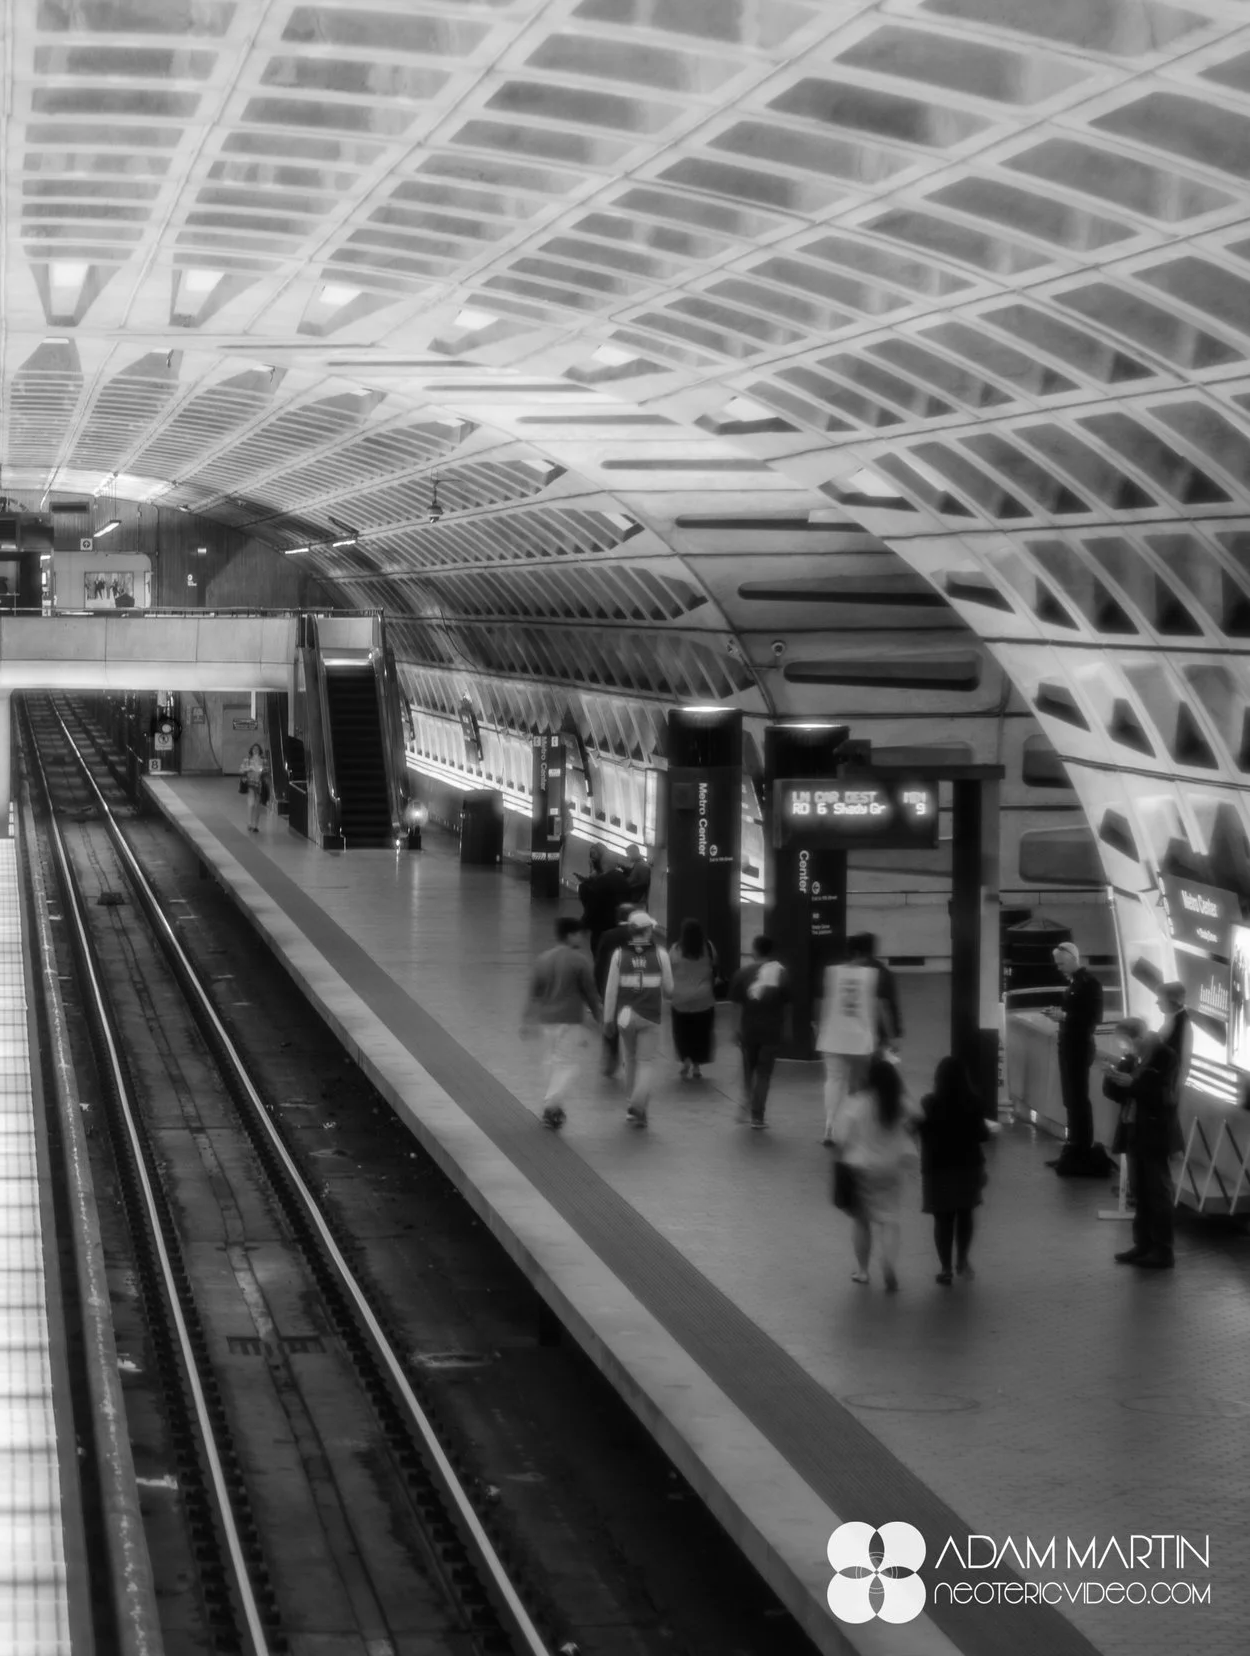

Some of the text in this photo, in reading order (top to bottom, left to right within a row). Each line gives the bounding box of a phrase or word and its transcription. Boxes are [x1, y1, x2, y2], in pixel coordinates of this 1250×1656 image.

[698, 783, 708, 856] Metro Center
[792, 803, 926, 815] RD 6 Shady Gr 9
[799, 850, 809, 893] Center
